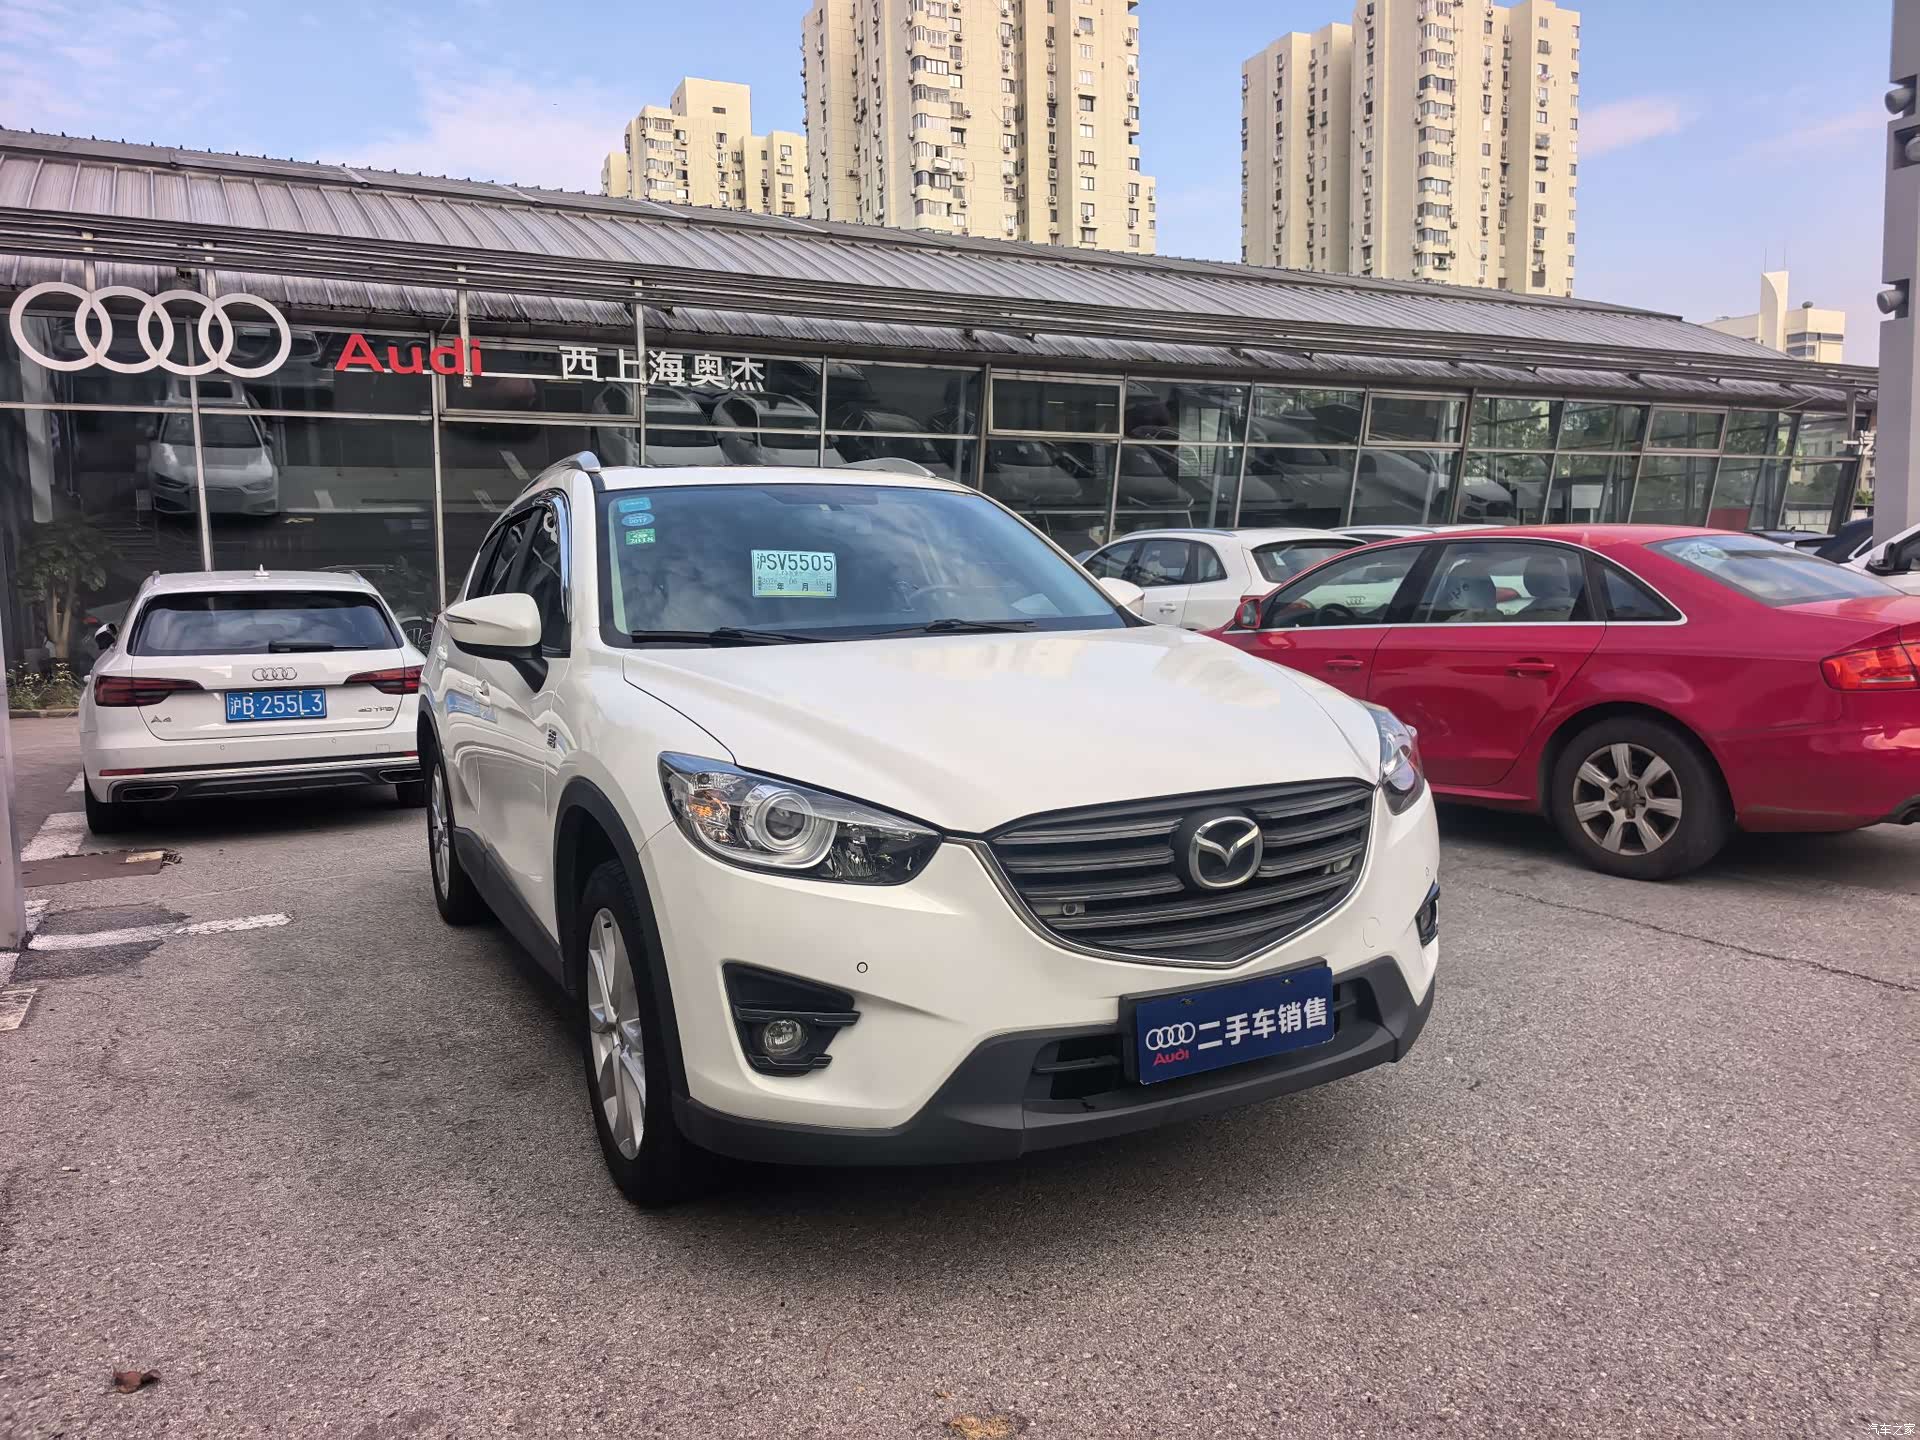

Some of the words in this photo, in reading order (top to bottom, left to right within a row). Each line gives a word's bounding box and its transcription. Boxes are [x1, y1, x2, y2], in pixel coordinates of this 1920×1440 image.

[335, 333, 482, 375] Audi
[559, 345, 765, 392] 西上海奥杰
[757, 553, 833, 571] 沪SV5505
[1197, 997, 1328, 1051] 二手车销售
[1153, 1048, 1191, 1066] Audi
